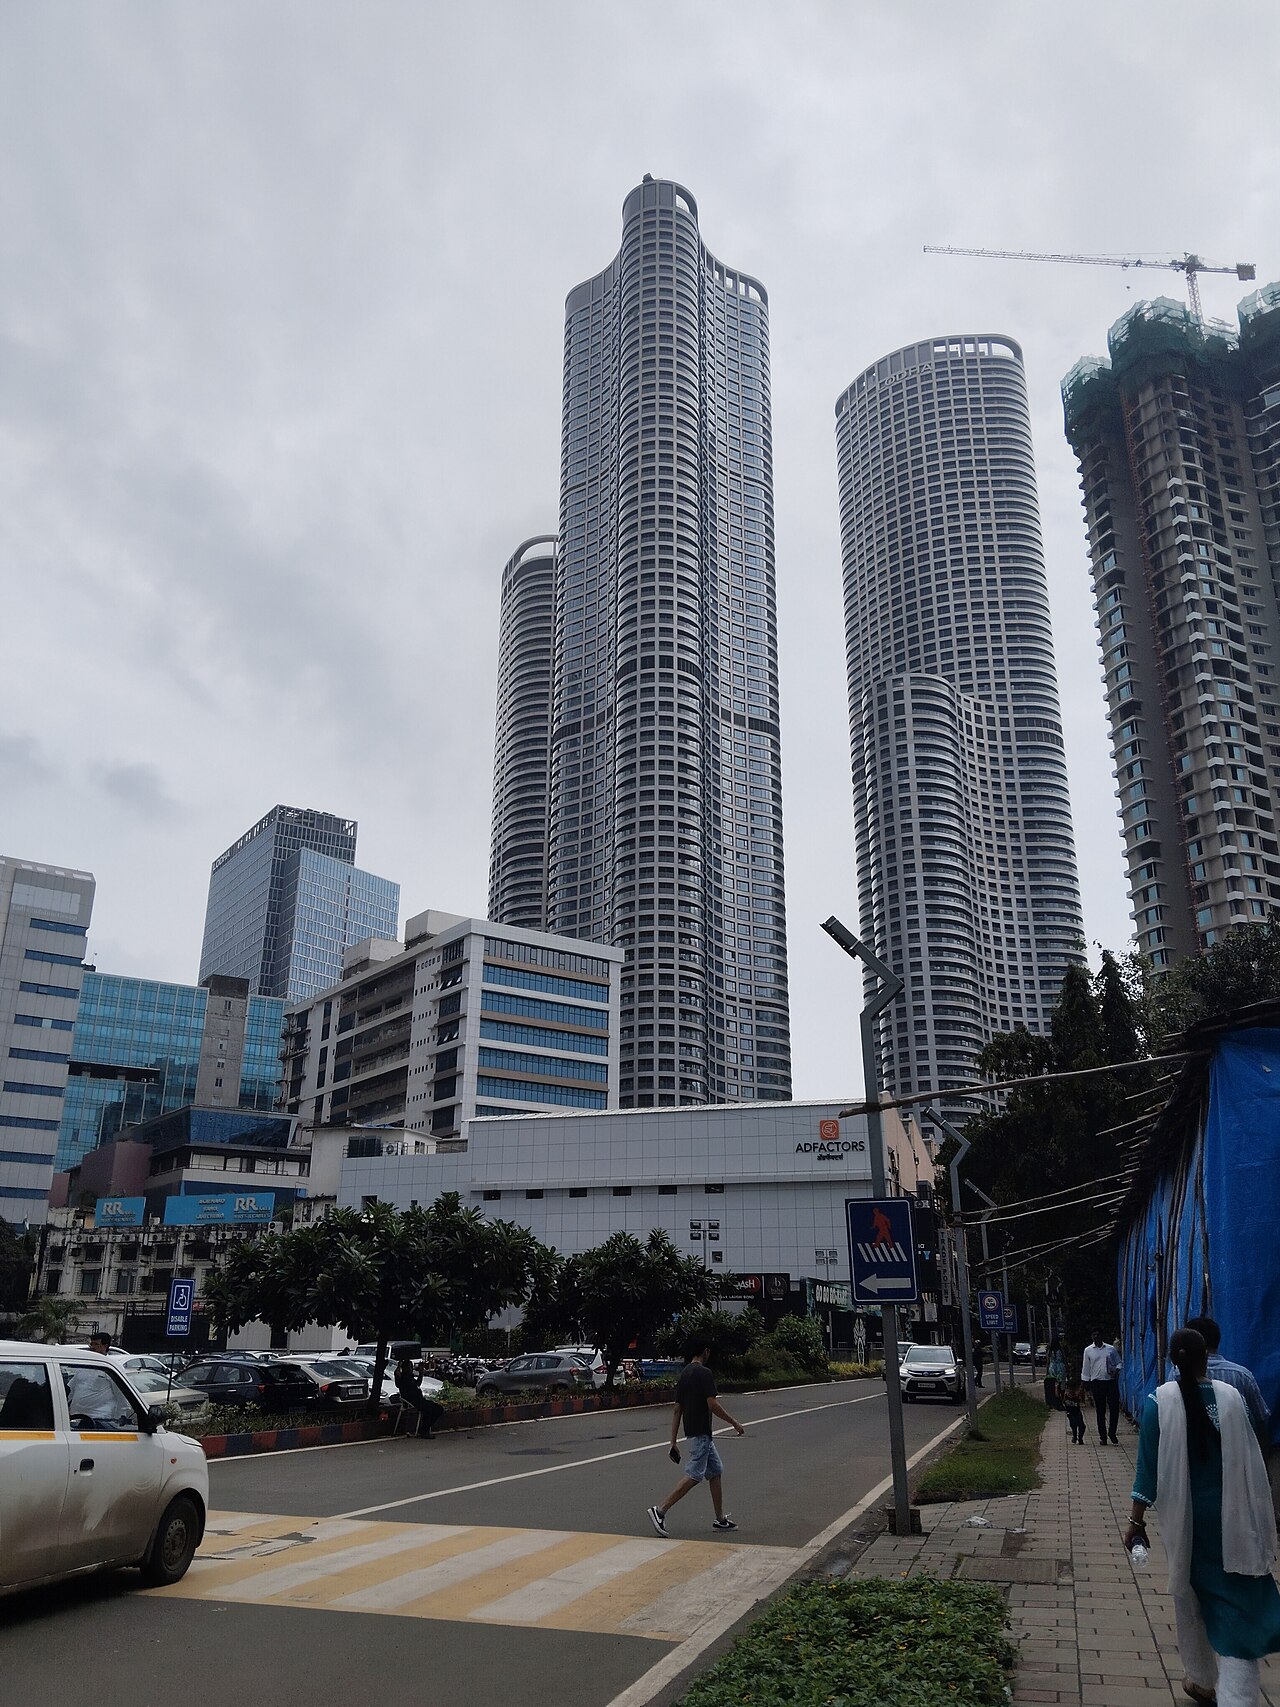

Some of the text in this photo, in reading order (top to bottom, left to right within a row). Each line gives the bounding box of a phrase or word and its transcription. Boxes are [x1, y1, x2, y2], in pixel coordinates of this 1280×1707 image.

[795, 1141, 865, 1152] ADFACTORS
[101, 1201, 124, 1215] RR
[233, 1197, 258, 1211] RR
[171, 1315, 188, 1323] DISABLE
[169, 1324, 188, 1332] PARKING
